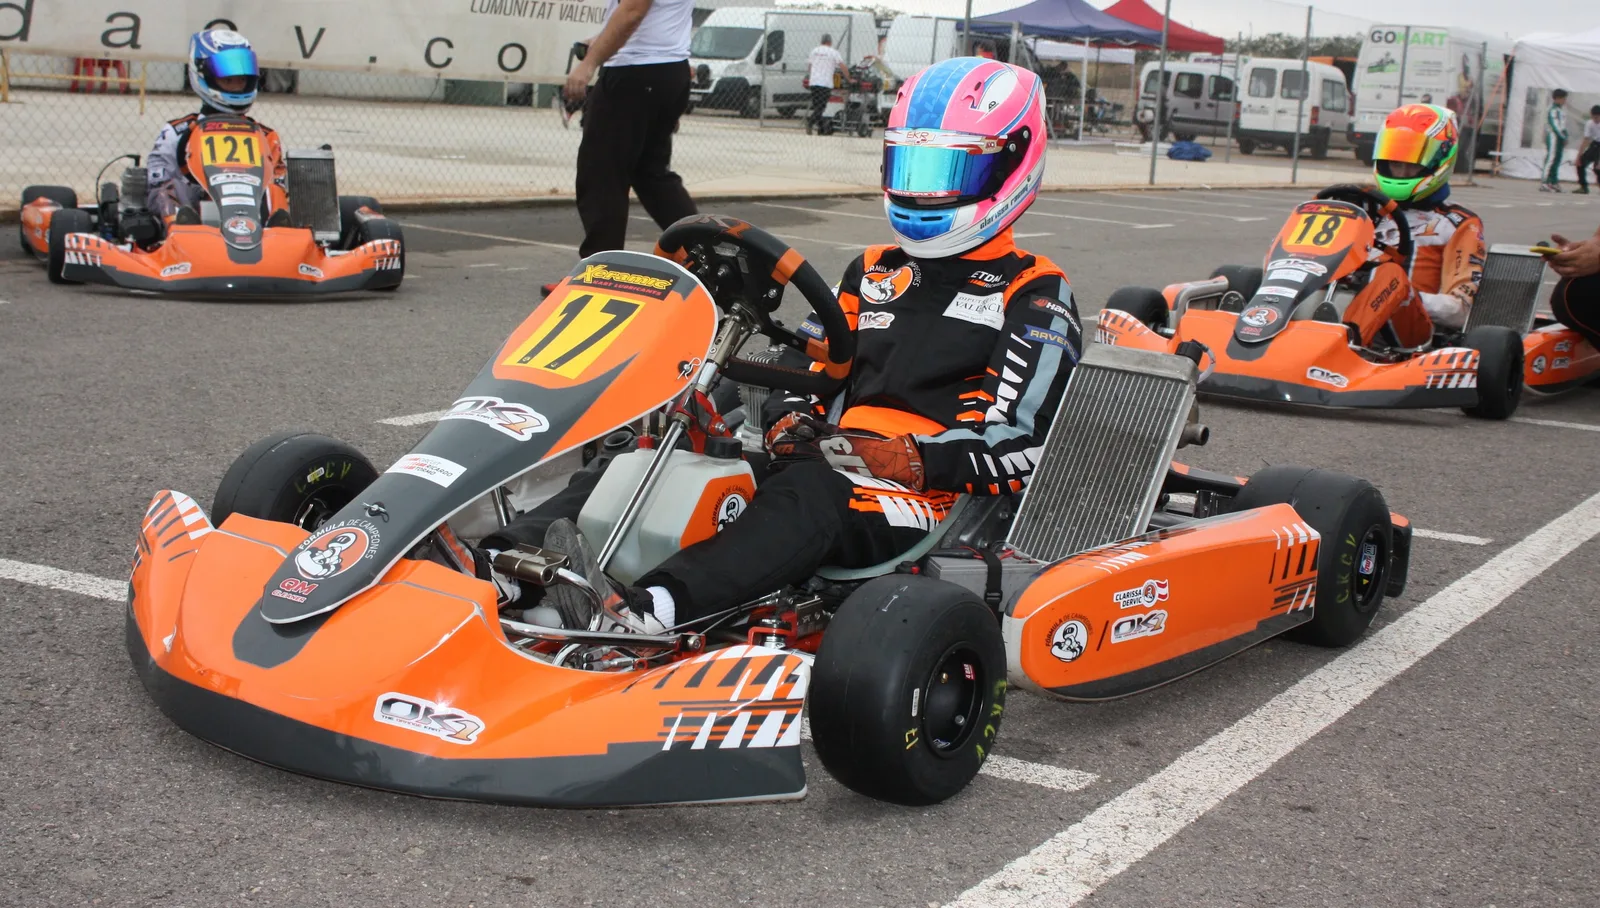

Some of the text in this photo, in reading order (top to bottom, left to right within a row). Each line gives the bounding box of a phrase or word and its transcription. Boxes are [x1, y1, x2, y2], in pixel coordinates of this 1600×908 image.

[470, 0, 556, 20] COMUNITAT
[205, 136, 254, 165] 121
[1295, 214, 1341, 246] 18
[592, 280, 662, 296] KART LUBRICANTS
[516, 294, 640, 370] 17
[1046, 302, 1081, 335] Hankook
[298, 519, 382, 560] FORMULA DE CAMPEONES
[279, 577, 319, 596] QM
[1115, 589, 1142, 601] CLARISSA
[1121, 597, 1142, 608] DERVIC
[1045, 618, 1063, 648] FORMULA
